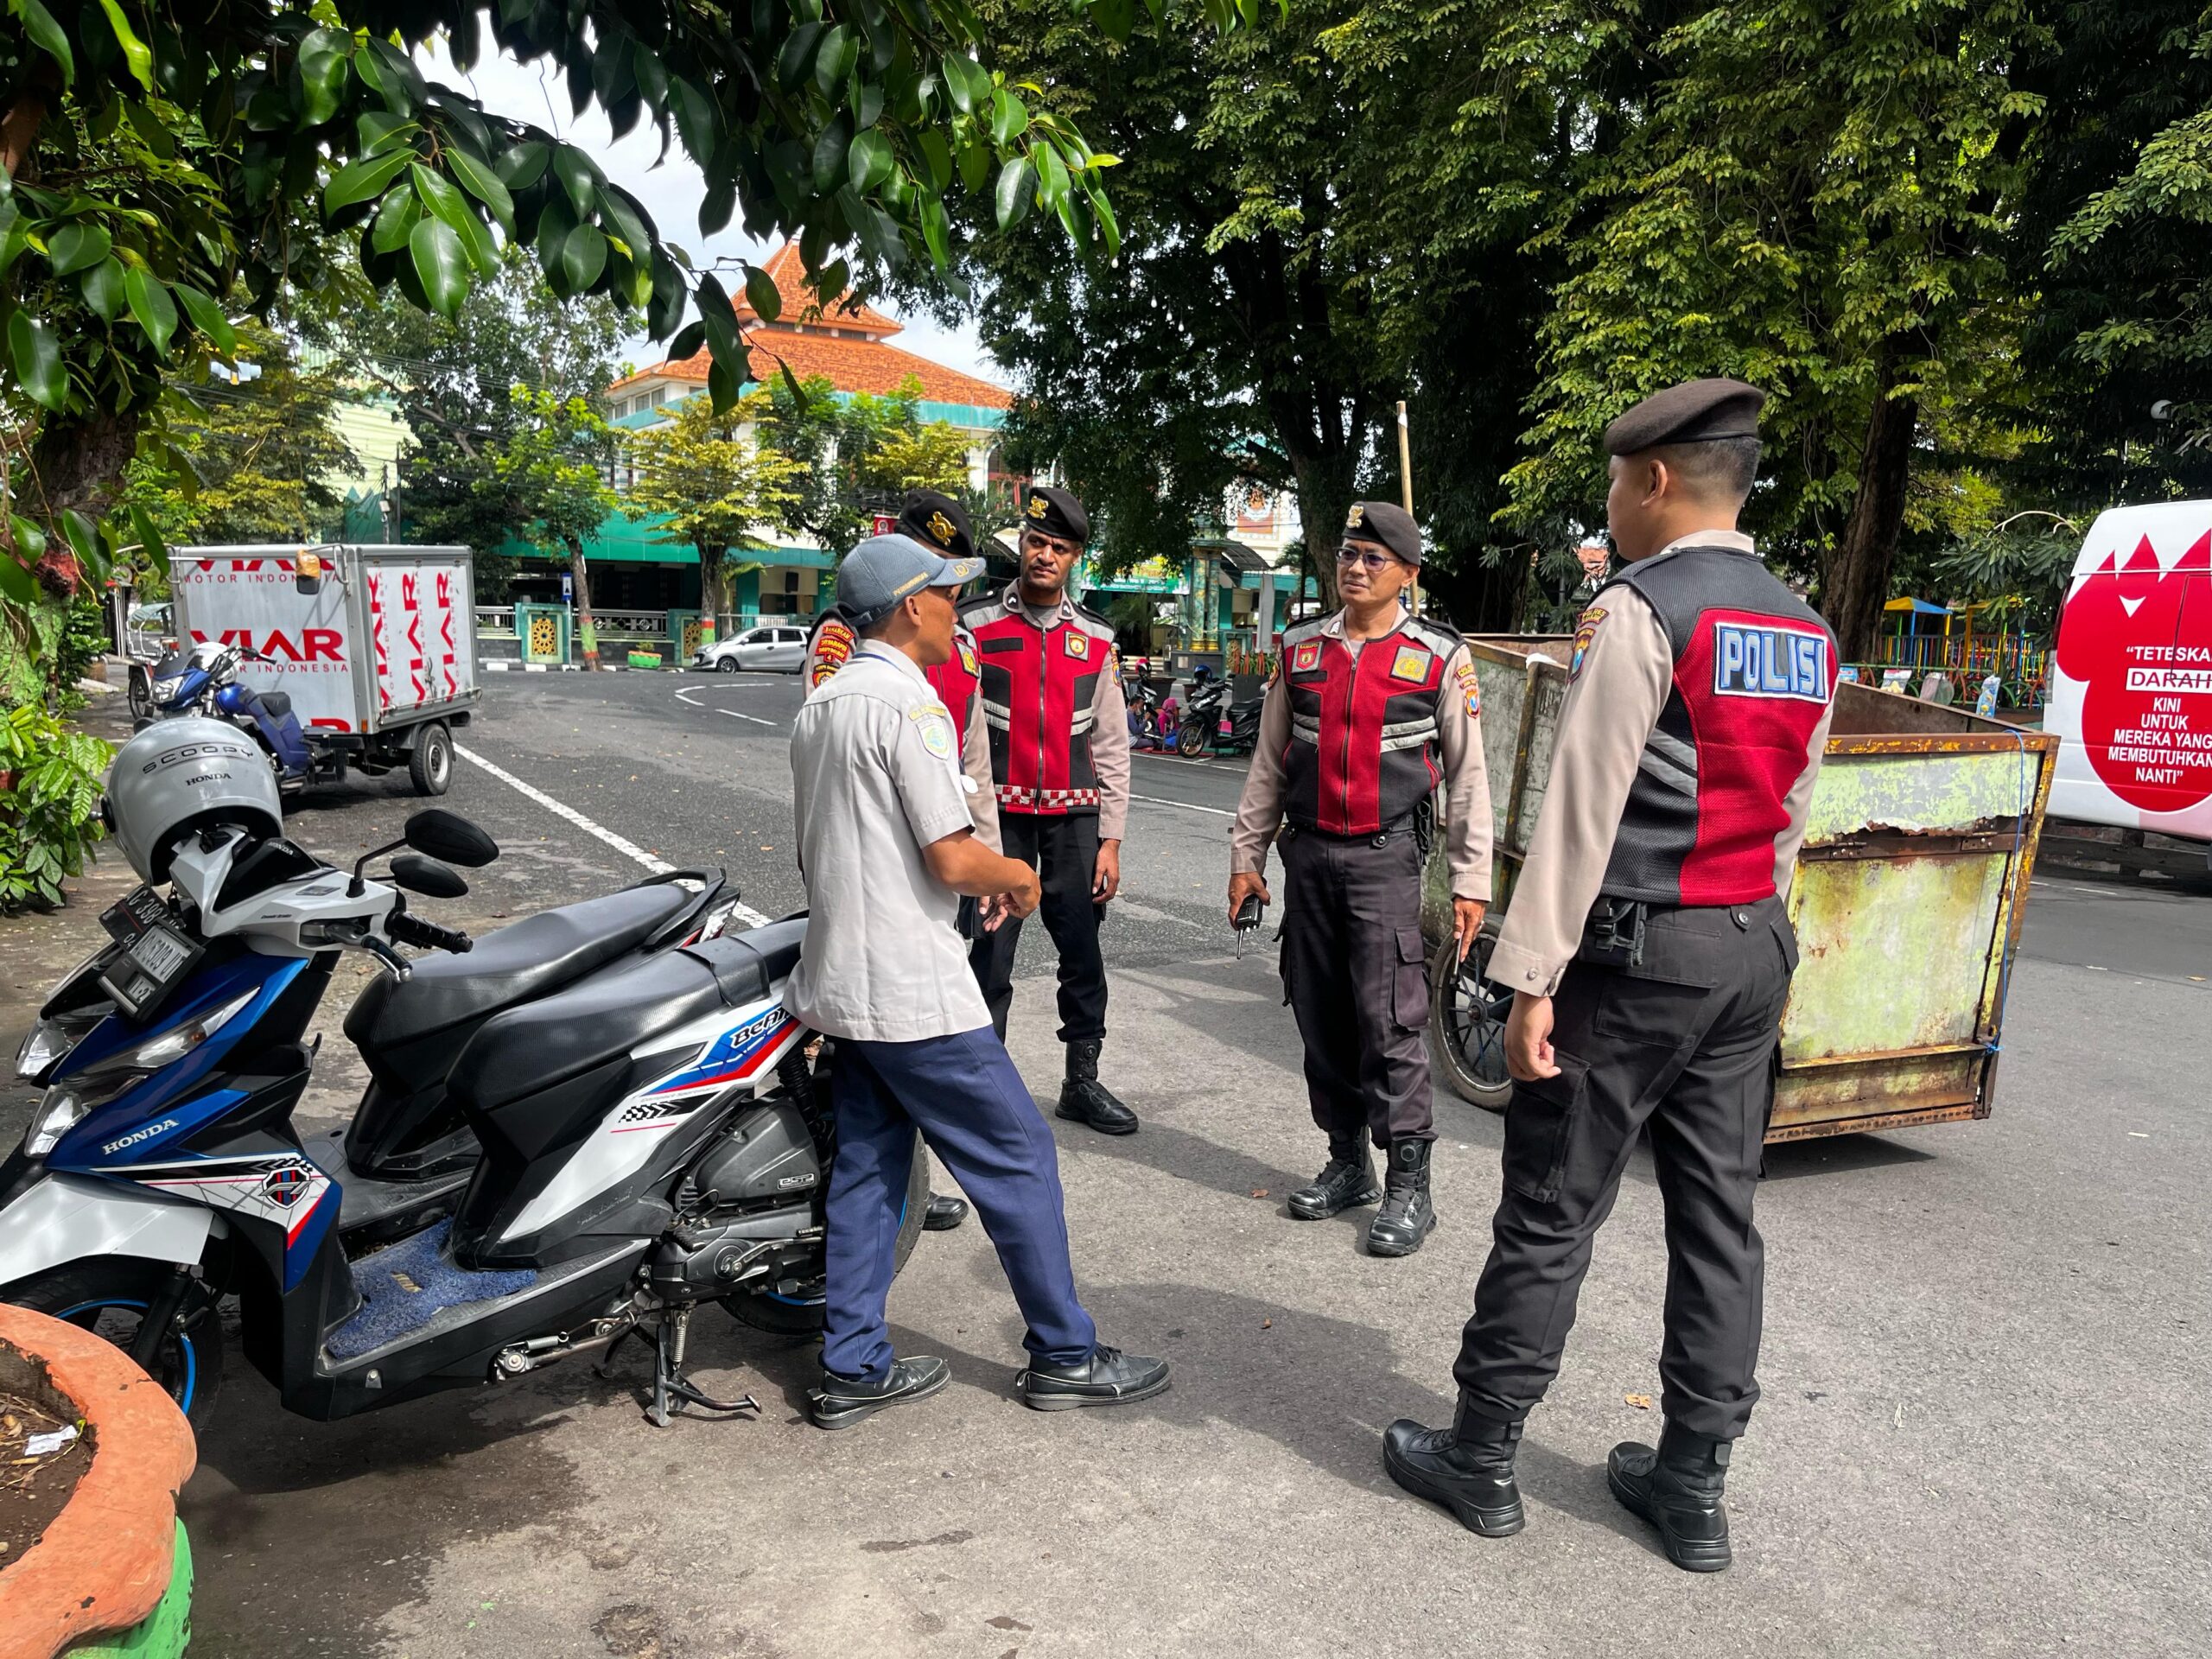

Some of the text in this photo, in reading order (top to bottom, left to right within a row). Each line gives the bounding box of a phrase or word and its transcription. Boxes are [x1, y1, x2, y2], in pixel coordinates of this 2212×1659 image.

[184, 574, 341, 584] MOTOR INDONIA
[402, 573, 426, 710] VIAR
[436, 572, 457, 702] VIAR
[1720, 628, 1824, 696] POLISI
[2126, 645, 2212, 663] “TETESKA
[258, 664, 349, 673] INDONESIA
[2131, 671, 2212, 689] DARAH
[2152, 696, 2182, 713] KINI
[2140, 714, 2190, 731] UNTUK
[2113, 728, 2212, 749] MEREKA YANG
[143, 745, 253, 774] SCOOPY
[2107, 746, 2212, 768] MEMBUTUHKAN
[186, 772, 232, 786] HONDA
[267, 842, 294, 855] HONDA
[102, 1119, 180, 1154] HONDA
